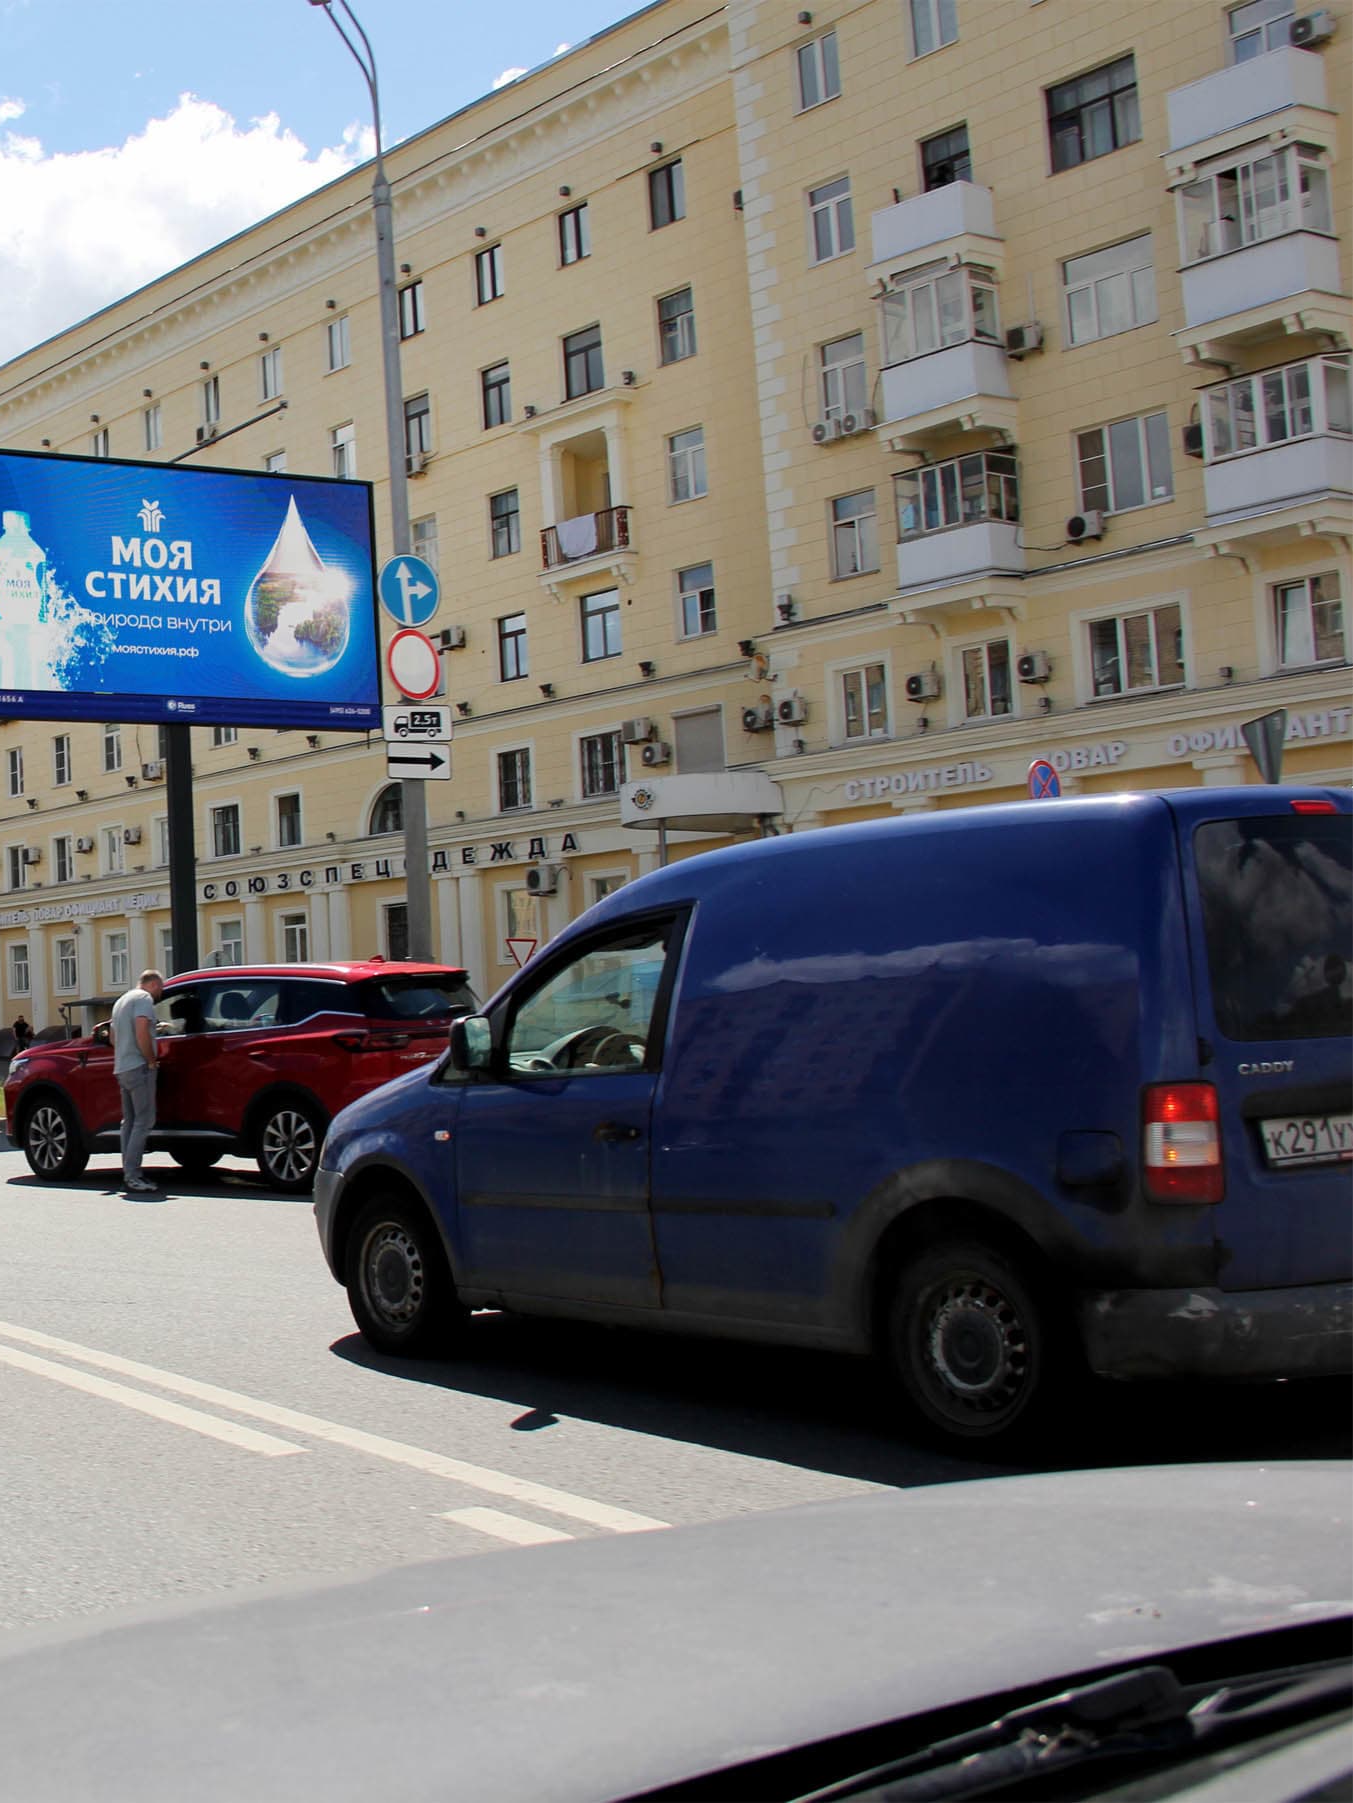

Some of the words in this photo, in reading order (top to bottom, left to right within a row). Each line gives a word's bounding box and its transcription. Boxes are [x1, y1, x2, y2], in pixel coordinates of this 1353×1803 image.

[112, 536, 193, 570] МОЯ
[85, 571, 221, 605] СТИХИЯ
[167, 615, 232, 634] внутри
[112, 643, 199, 658] моястихия.рф
[1167, 708, 1352, 757] ОФИАНТ
[1032, 741, 1126, 772] ОВАР
[844, 761, 993, 801] СТРОИТЕЛЬ
[203, 833, 578, 899] СОЮЗСПЕЦДЕЖДА
[1238, 1060, 1294, 1075] CADDY
